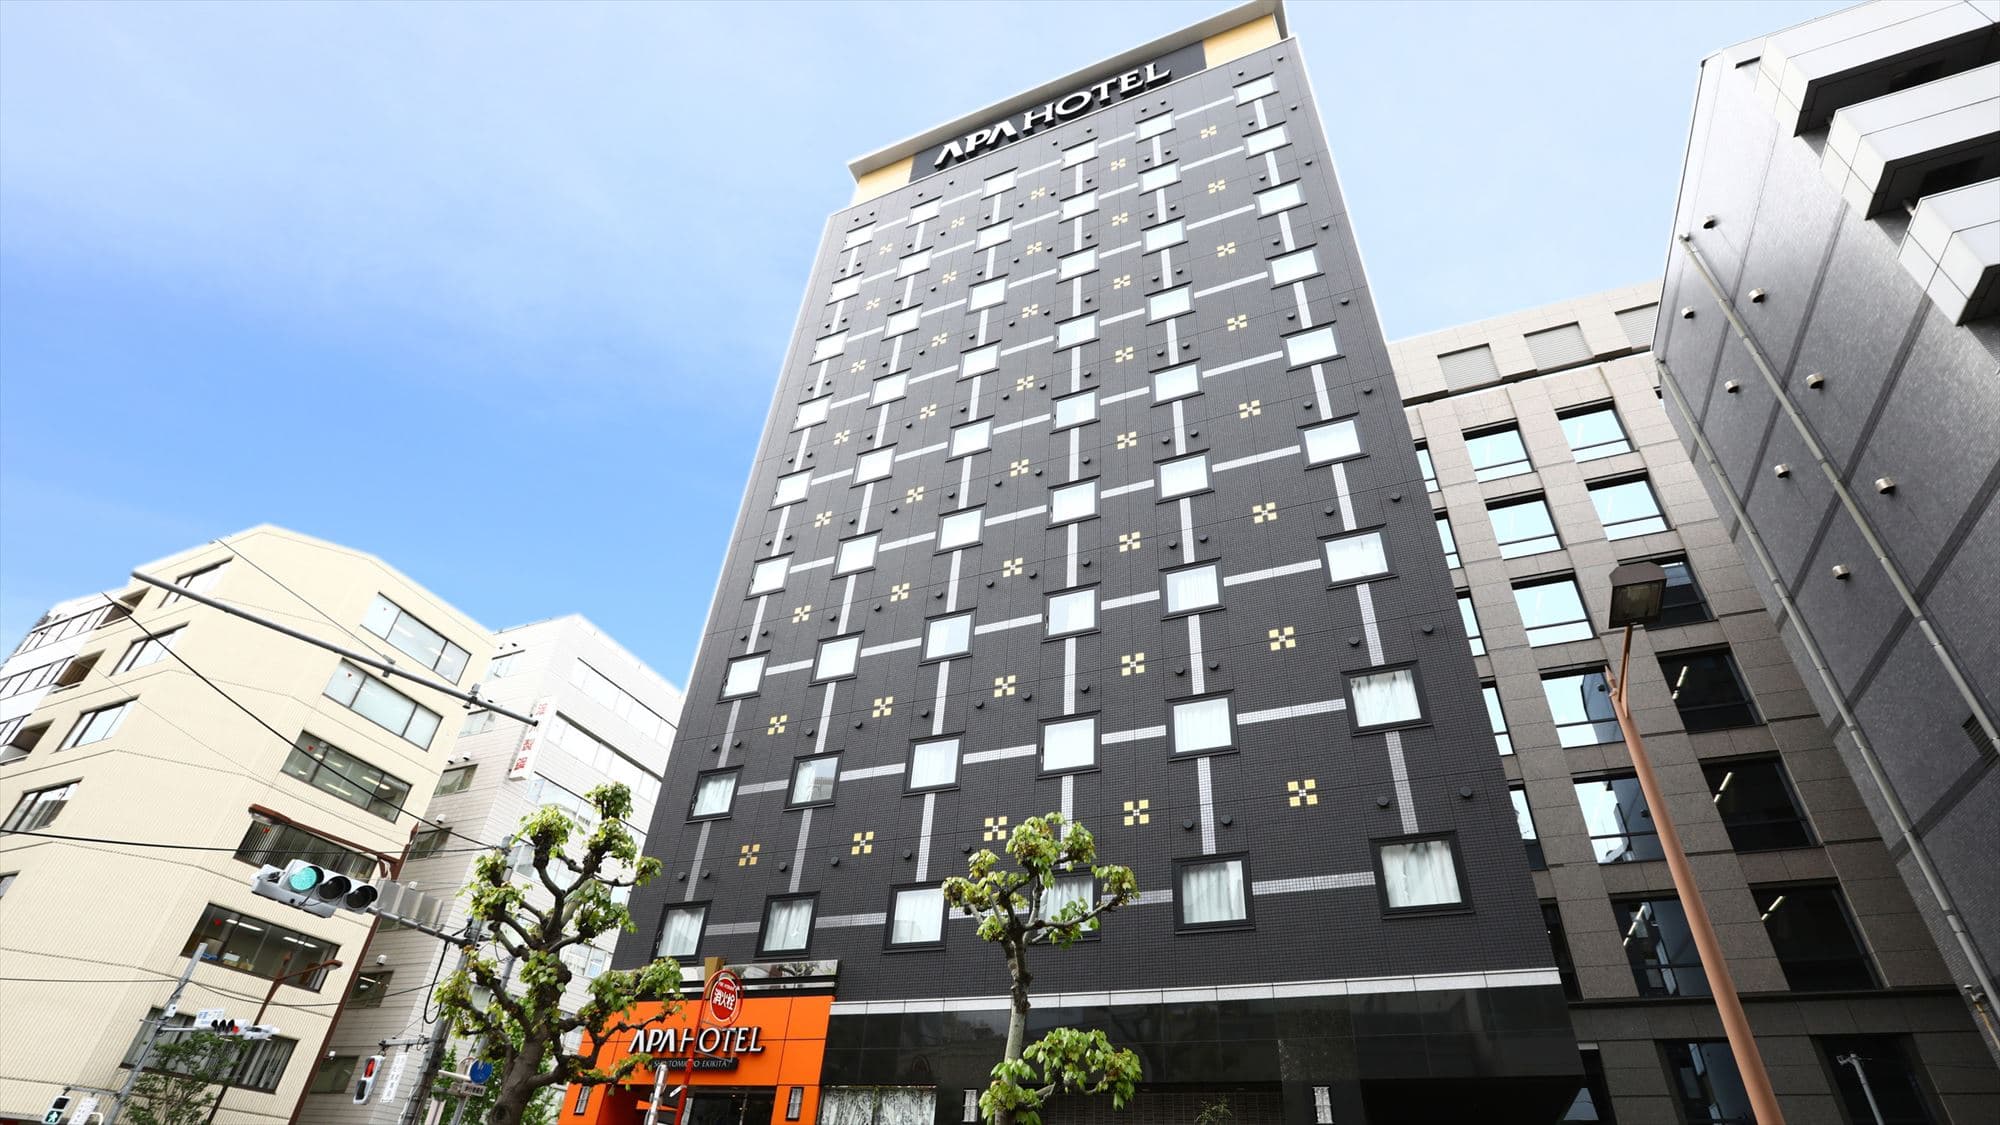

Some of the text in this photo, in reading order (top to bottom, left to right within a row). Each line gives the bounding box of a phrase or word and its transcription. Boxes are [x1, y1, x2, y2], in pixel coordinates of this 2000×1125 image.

[933, 62, 1172, 169] APA HOTEL
[712, 988, 736, 1011] 消火栓
[628, 1026, 763, 1053] APA HOTEL
